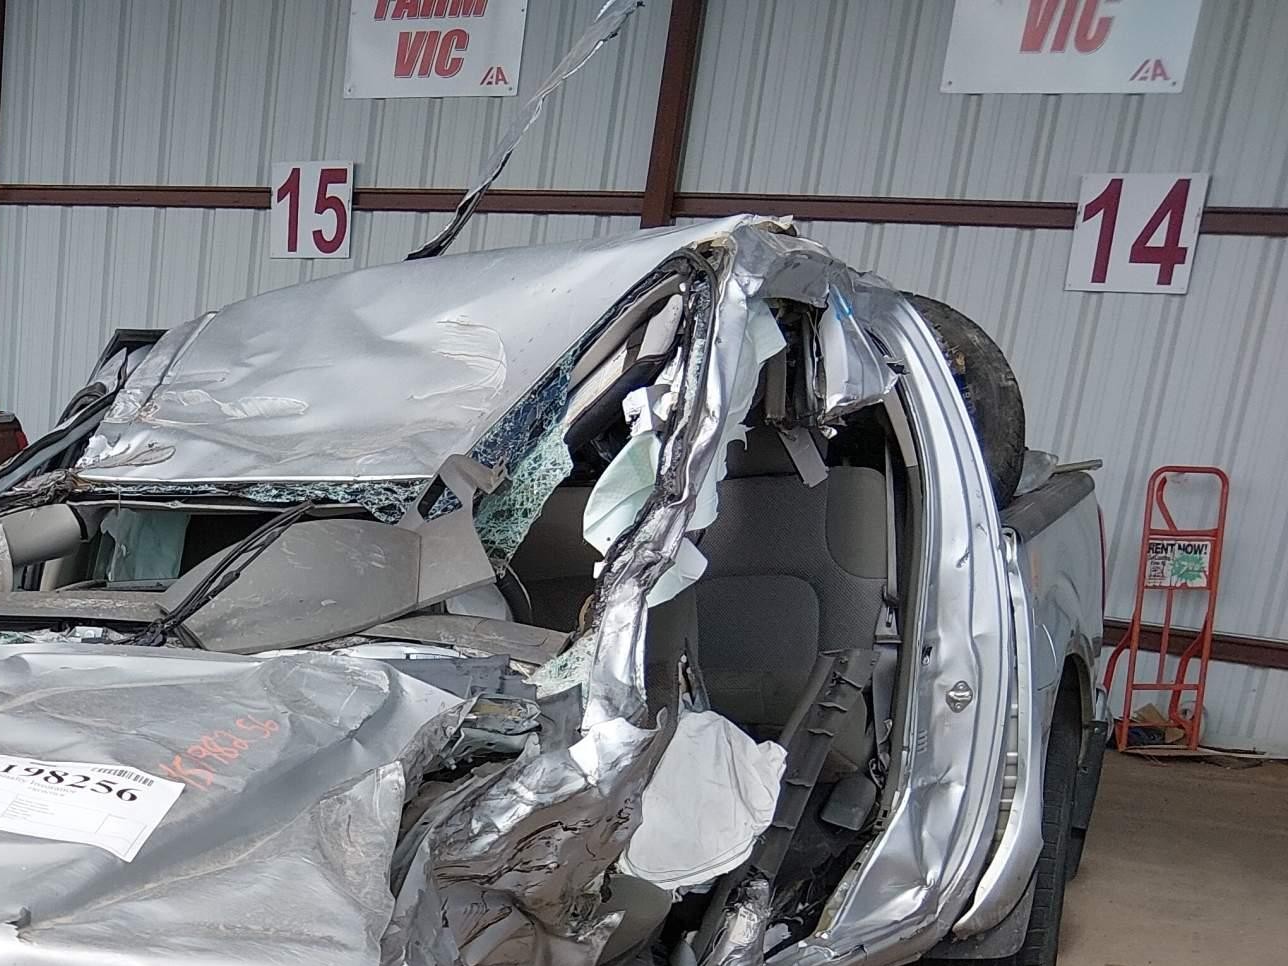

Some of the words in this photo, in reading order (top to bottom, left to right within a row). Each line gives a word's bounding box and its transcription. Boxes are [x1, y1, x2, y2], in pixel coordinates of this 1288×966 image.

[394, 28, 470, 78] VIC
[276, 167, 348, 254] 15
[1082, 178, 1192, 286] 14
[1147, 543, 1176, 555] RENT
[1178, 543, 1208, 555] NOW!
